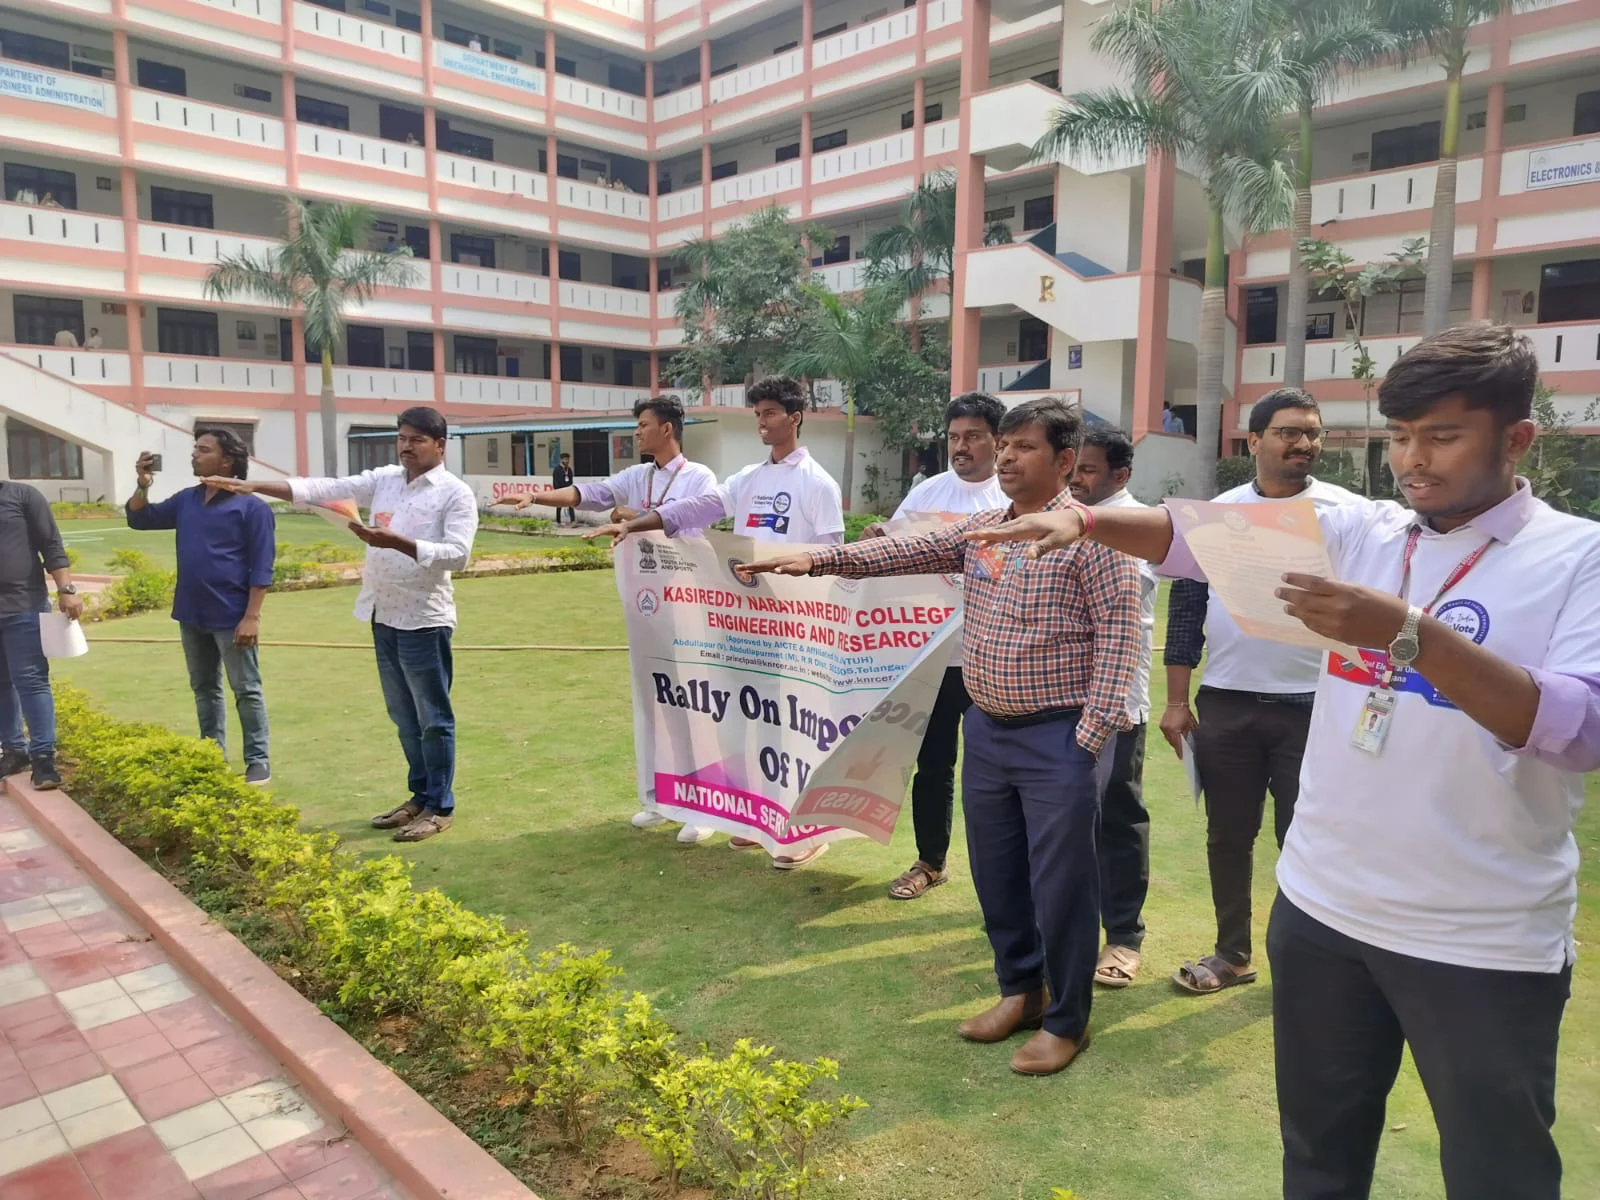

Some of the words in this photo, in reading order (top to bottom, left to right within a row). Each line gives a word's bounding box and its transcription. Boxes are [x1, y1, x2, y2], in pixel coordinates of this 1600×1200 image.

[0, 65, 43, 84] PARTMENT
[46, 75, 57, 86] OF
[491, 71, 537, 91] ENGINEERING
[0, 79, 33, 95] USINESS
[36, 86, 103, 107] ADMINISTRATION
[1530, 162, 1592, 183] ELECTRONICS
[1039, 275, 1056, 302] R
[663, 586, 742, 609] KASIREDDY
[746, 595, 852, 626] NARAYANREDDY
[708, 611, 806, 640] ENGINEERING
[809, 625, 835, 646] AND
[1453, 623, 1476, 634] Vote
[673, 638, 716, 650] Abdullapur
[729, 644, 784, 659] Abdullapurmet
[700, 650, 720, 660] Email
[763, 640, 772, 649] by
[774, 641, 799, 651] AICTE
[652, 673, 730, 723] Rally
[739, 685, 781, 726] On
[786, 694, 868, 751] Impo
[759, 746, 790, 788] Of
[795, 757, 811, 793] V
[674, 781, 757, 820] NATIONAL
